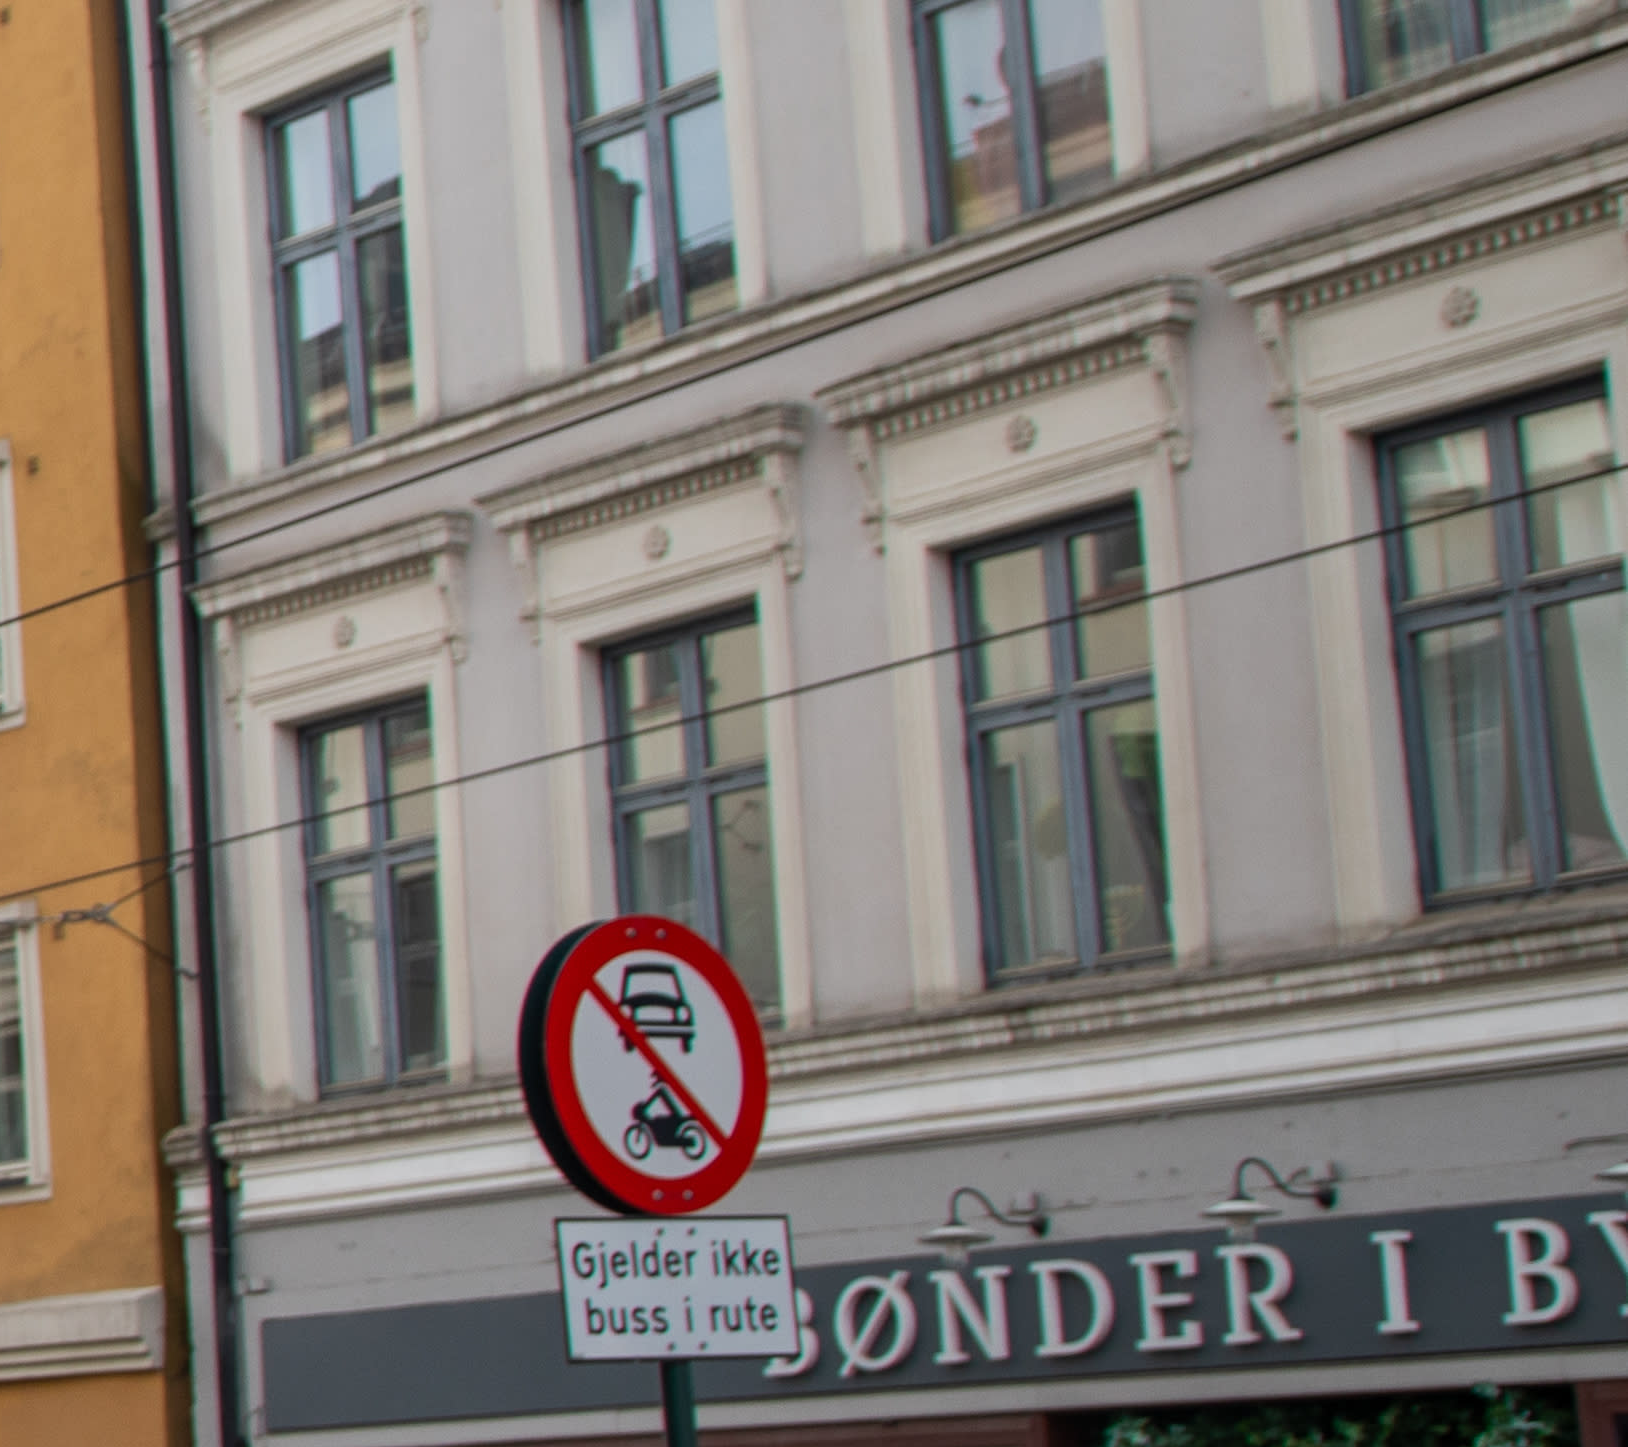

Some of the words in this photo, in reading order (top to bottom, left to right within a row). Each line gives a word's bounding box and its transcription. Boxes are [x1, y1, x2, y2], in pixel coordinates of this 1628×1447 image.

[571, 1238, 697, 1290] Gjelder
[710, 1239, 781, 1277] ikke
[1369, 1229, 1420, 1336] I
[583, 1297, 670, 1335] buss
[684, 1296, 694, 1333] i
[708, 1297, 779, 1333] rute
